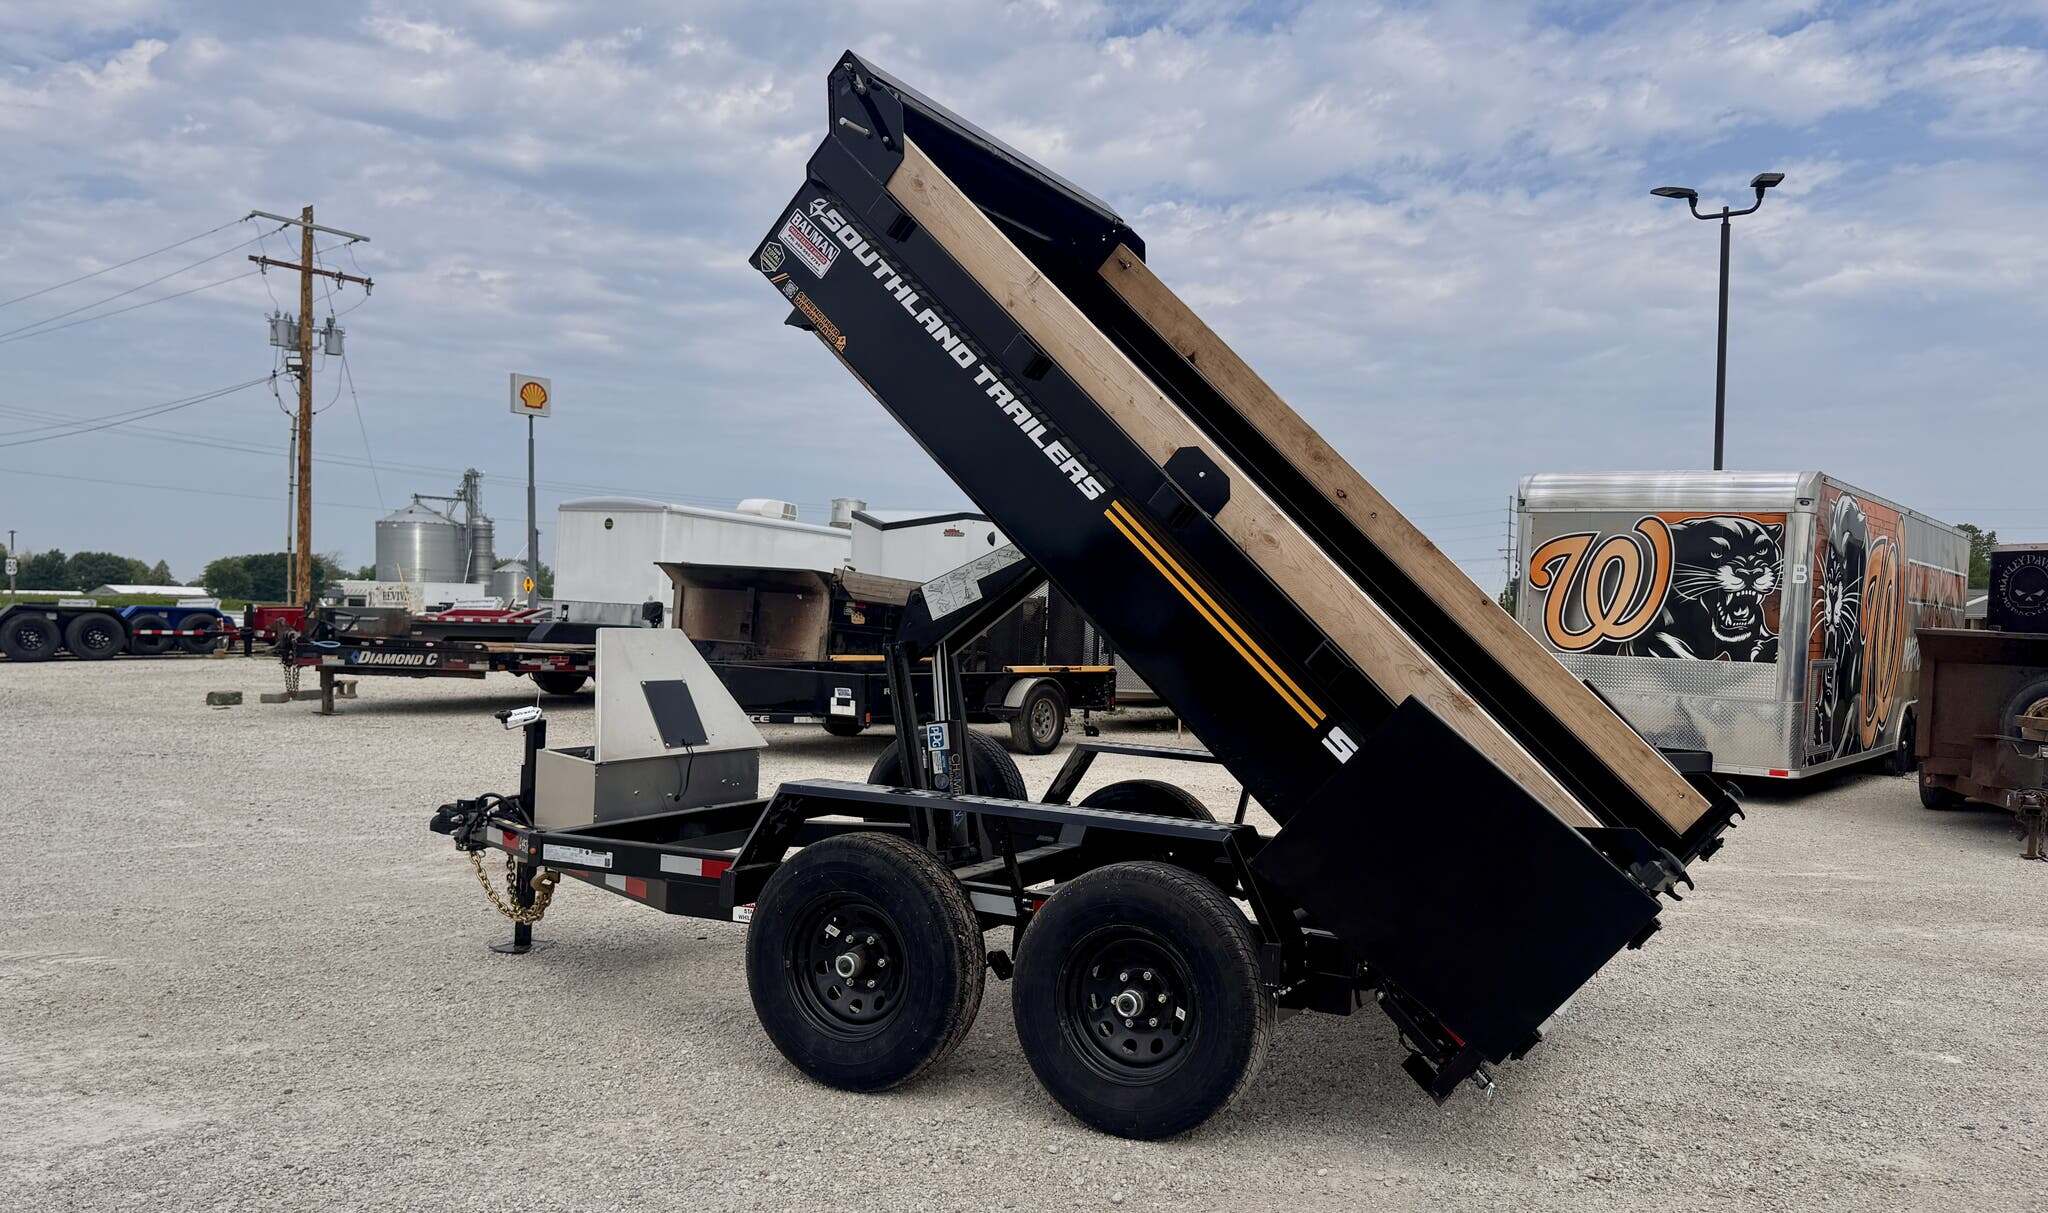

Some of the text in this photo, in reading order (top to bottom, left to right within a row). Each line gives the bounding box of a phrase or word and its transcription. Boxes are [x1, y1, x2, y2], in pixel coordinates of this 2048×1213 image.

[791, 212, 838, 260] BAUMAN
[820, 209, 1106, 501] SOUTHLAND TRAILERS
[1529, 515, 1675, 652] W
[1792, 563, 1807, 584] B
[358, 651, 438, 666] DIAMOND C
[1321, 726, 1359, 764] S
